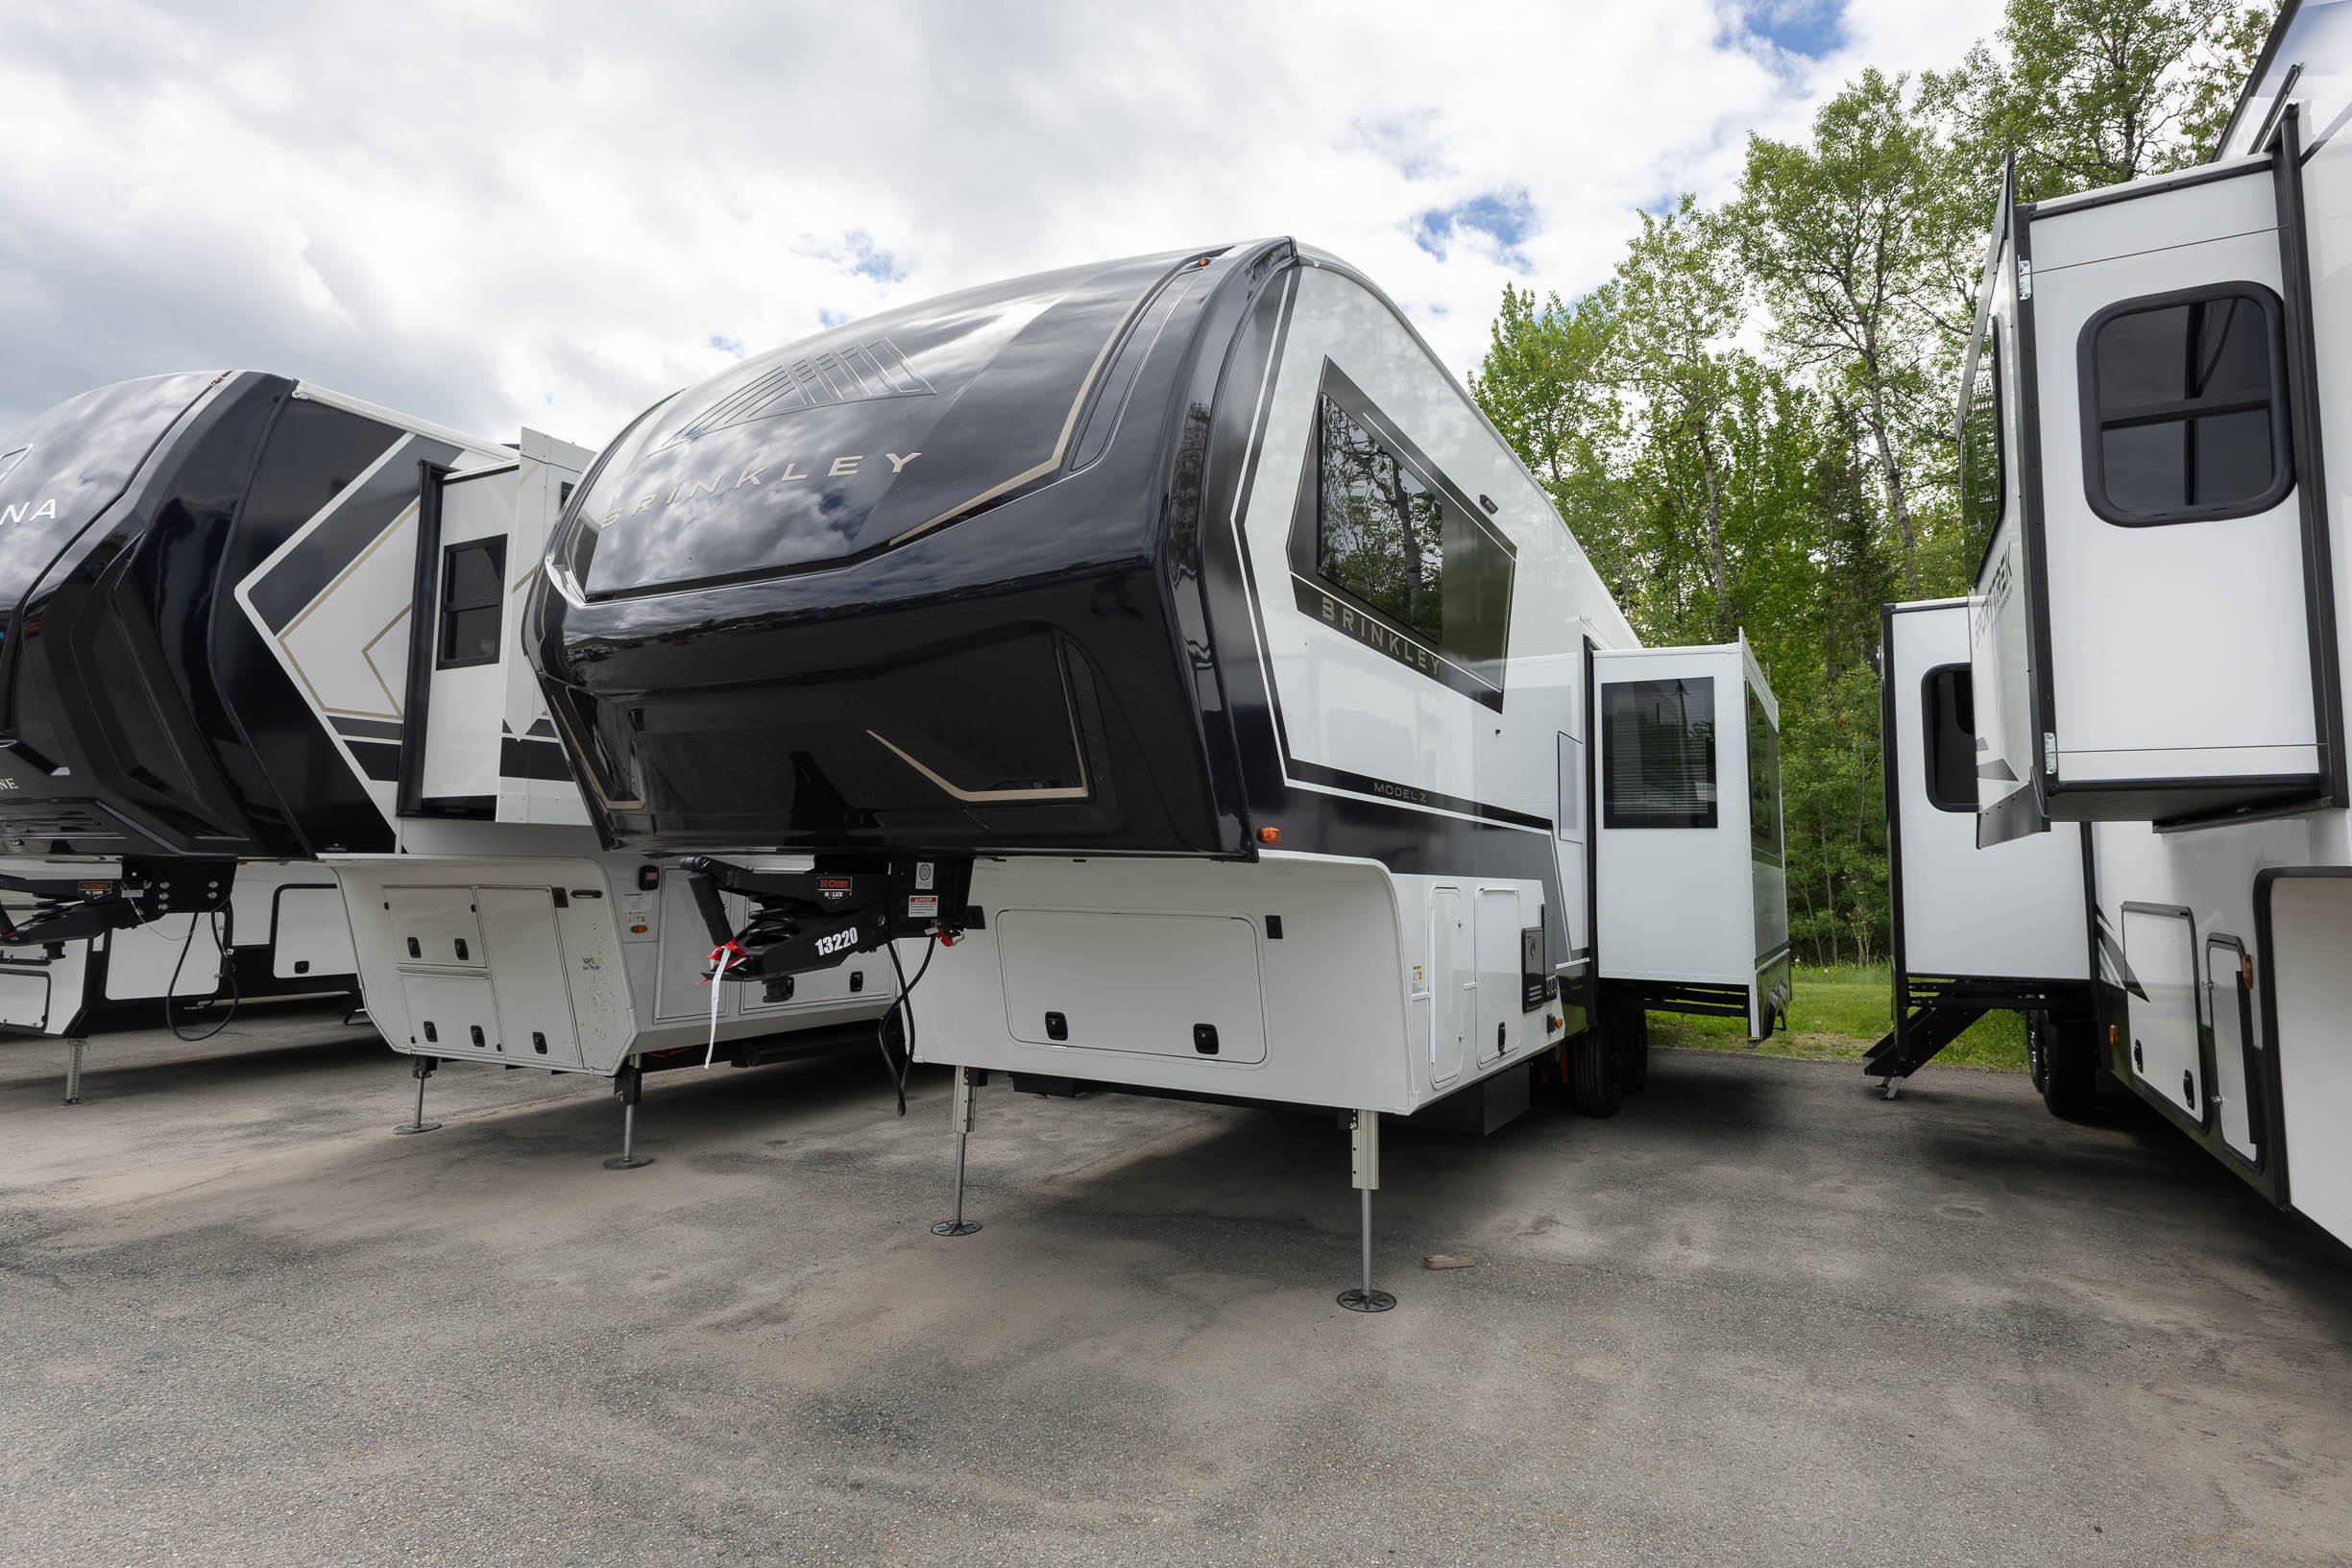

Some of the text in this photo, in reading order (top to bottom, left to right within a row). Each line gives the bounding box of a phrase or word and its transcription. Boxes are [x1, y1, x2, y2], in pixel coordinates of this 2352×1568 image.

[601, 452, 922, 530] BRINKLEY
[1321, 596, 1441, 675] BRINKLEY
[1373, 782, 1428, 803] MODEL Z
[814, 927, 859, 956] 13220
